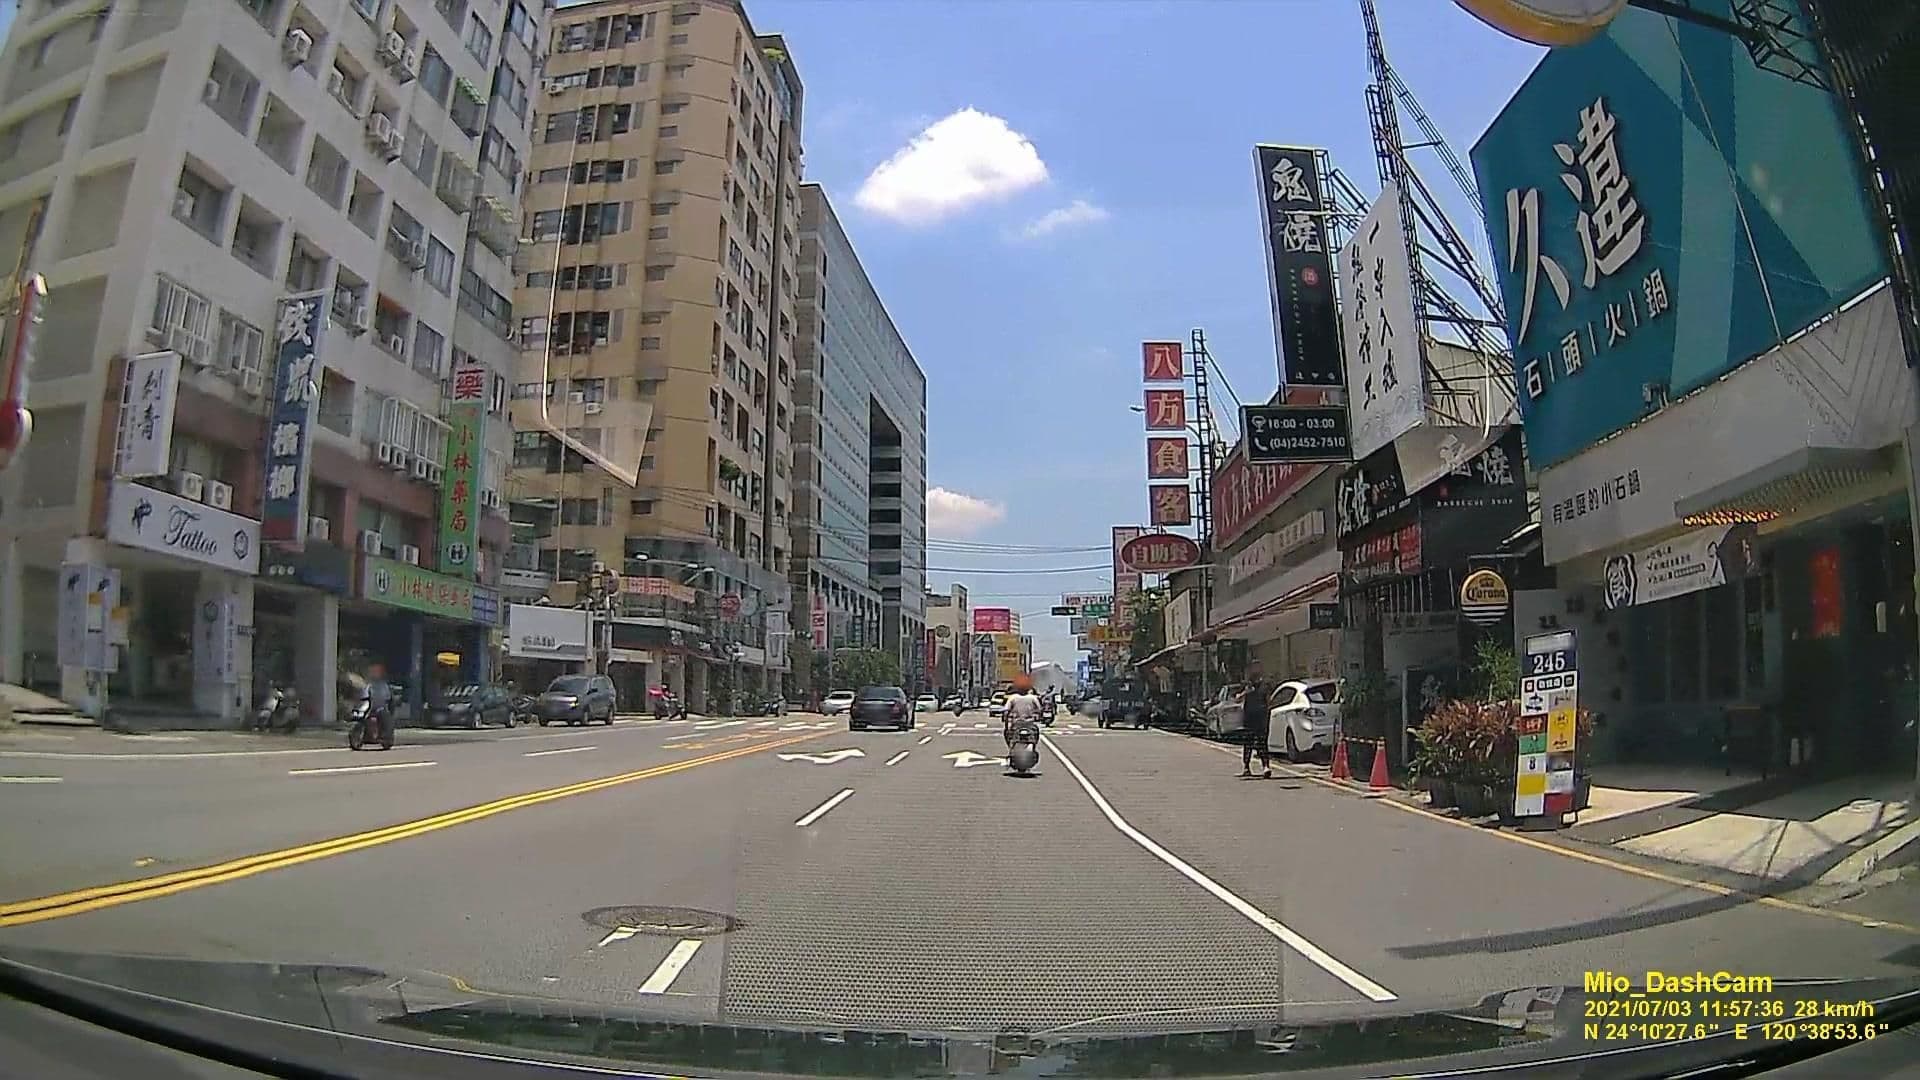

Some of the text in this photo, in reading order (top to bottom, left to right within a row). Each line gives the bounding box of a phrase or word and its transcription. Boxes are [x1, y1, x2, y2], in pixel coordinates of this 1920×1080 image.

[1150, 347, 1186, 522] 八方食客
[1306, 418, 1335, 429] 03:00
[1269, 435, 1346, 449] (04)2452-7510
[450, 424, 475, 532] 小林藥局
[163, 505, 219, 556] Tattoo
[1131, 544, 1188, 568] 自助餐
[1466, 586, 1506, 603] Corona
[1533, 652, 1566, 675] 245
